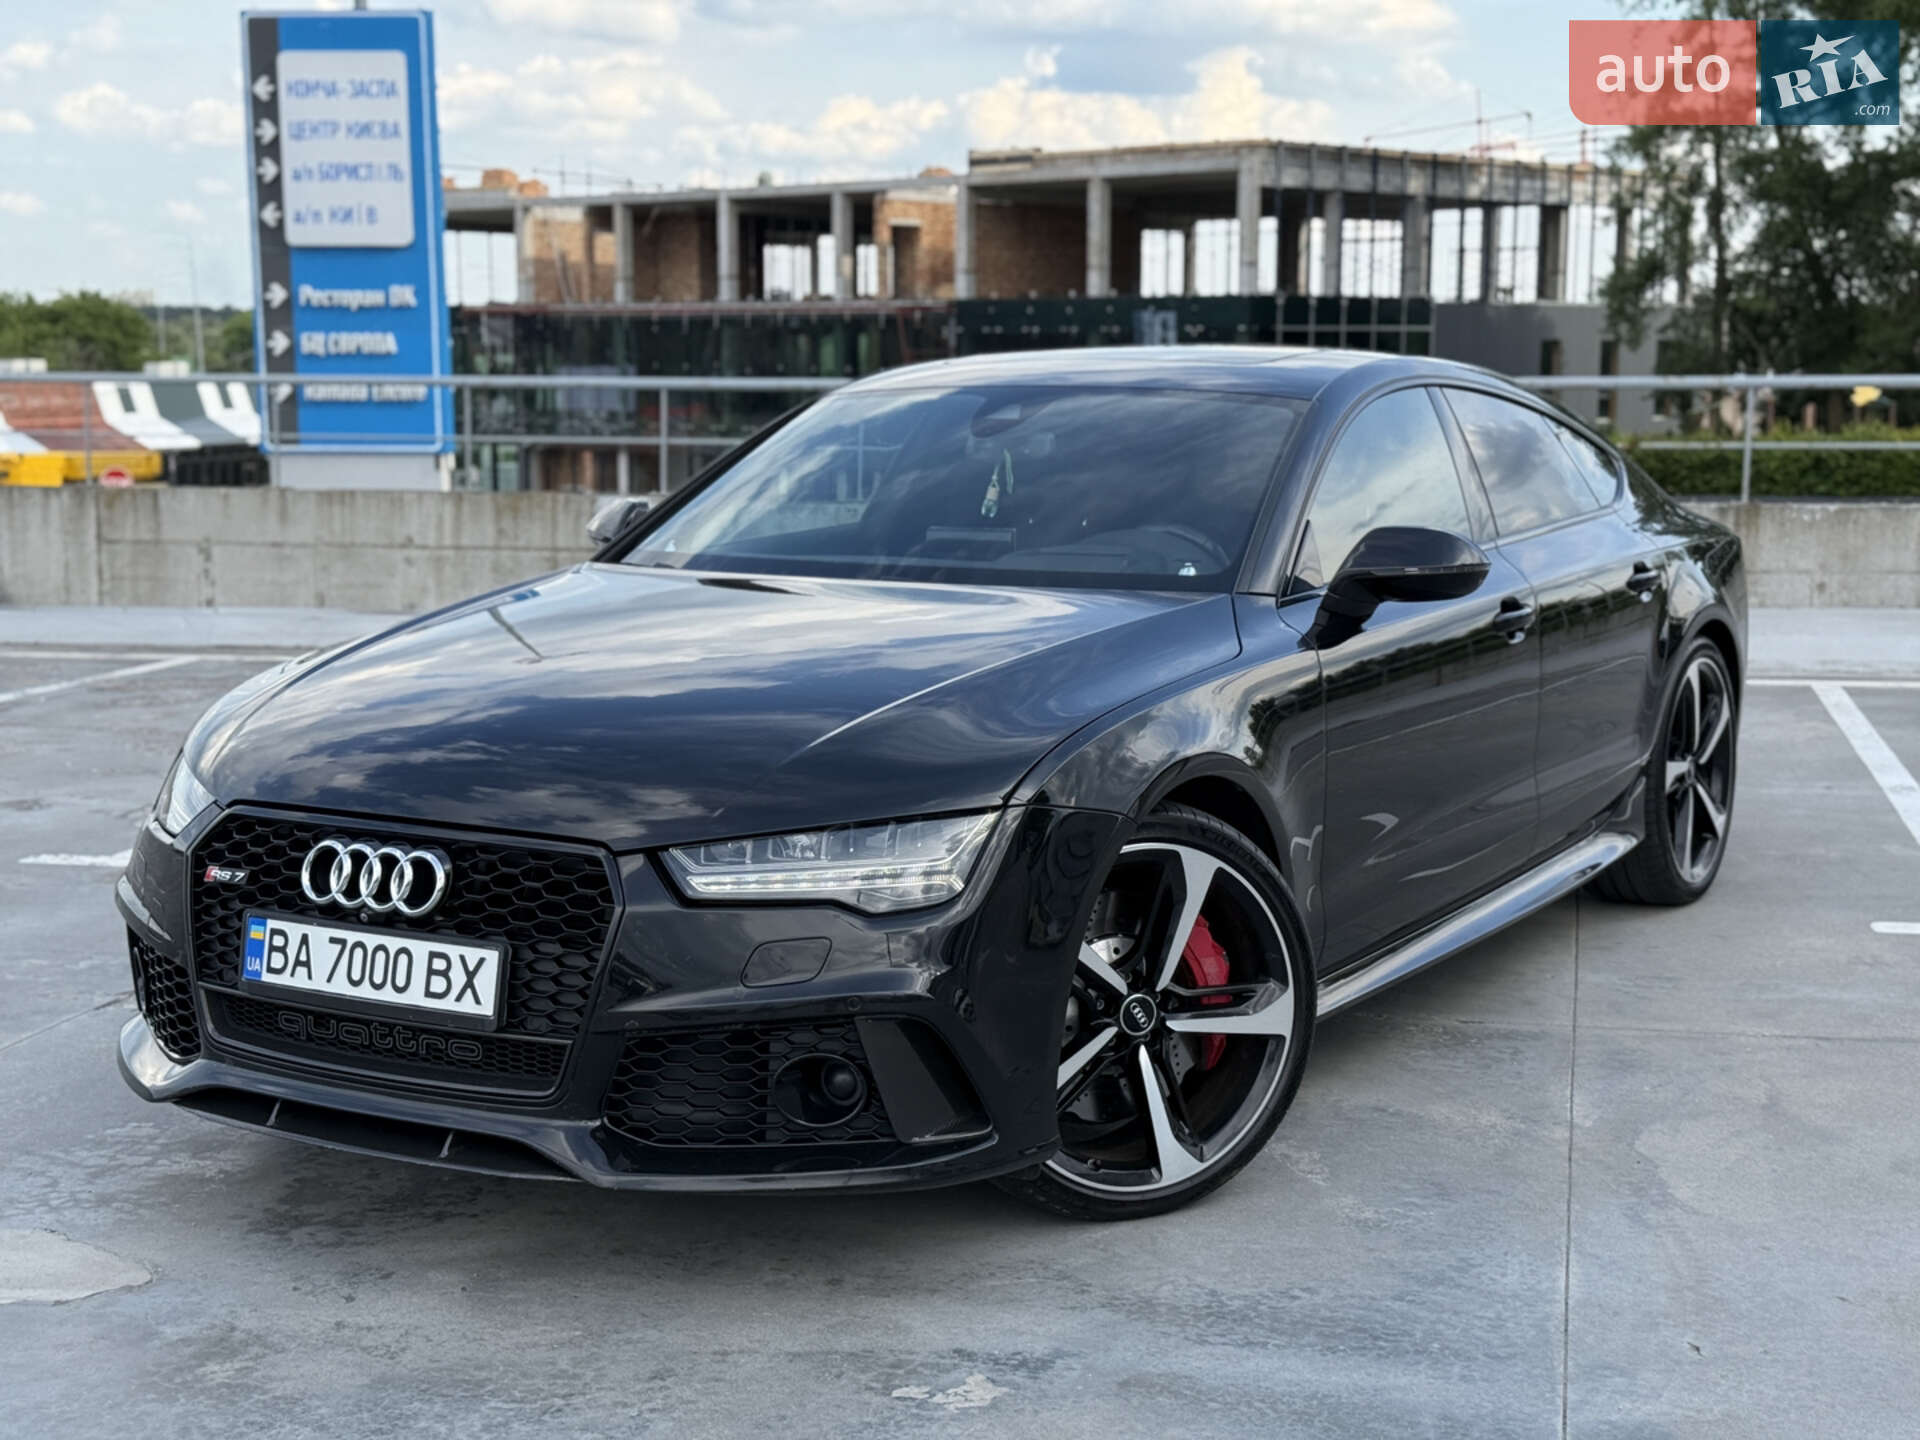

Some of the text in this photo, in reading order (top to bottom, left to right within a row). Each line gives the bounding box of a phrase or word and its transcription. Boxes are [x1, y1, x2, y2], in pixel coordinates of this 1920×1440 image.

[247, 955, 261, 973] UA
[265, 927, 487, 1006] BA 7000 BX
[278, 1011, 483, 1061] quattro
